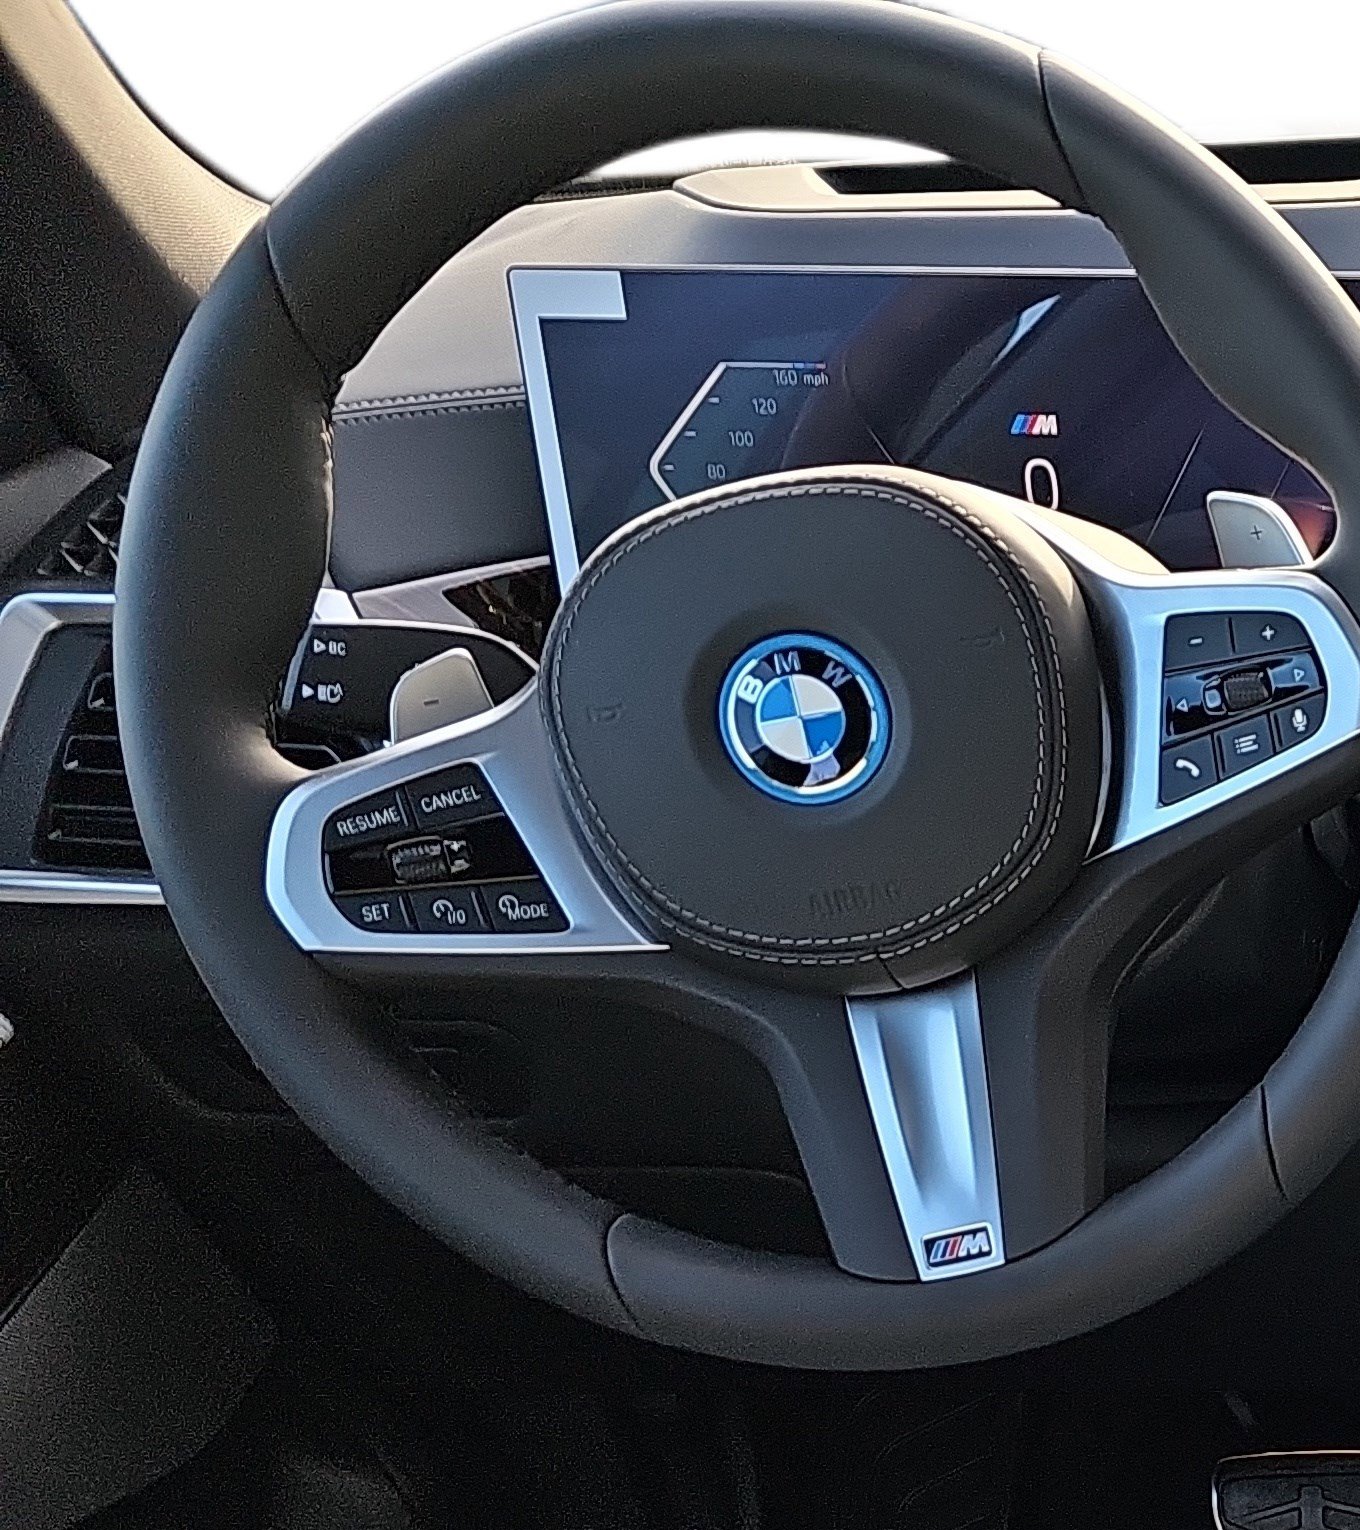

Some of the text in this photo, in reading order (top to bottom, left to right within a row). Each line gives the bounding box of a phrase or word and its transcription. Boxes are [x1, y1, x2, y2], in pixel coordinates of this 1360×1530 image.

[803, 372, 829, 387] mph
[752, 397, 777, 415] 120
[728, 430, 754, 447] 100
[707, 463, 726, 480] 80
[737, 650, 853, 704] BMW
[421, 785, 482, 812] CANCEL
[336, 806, 401, 836] RESUME
[361, 902, 390, 922] SET
[508, 903, 549, 921] MODE
